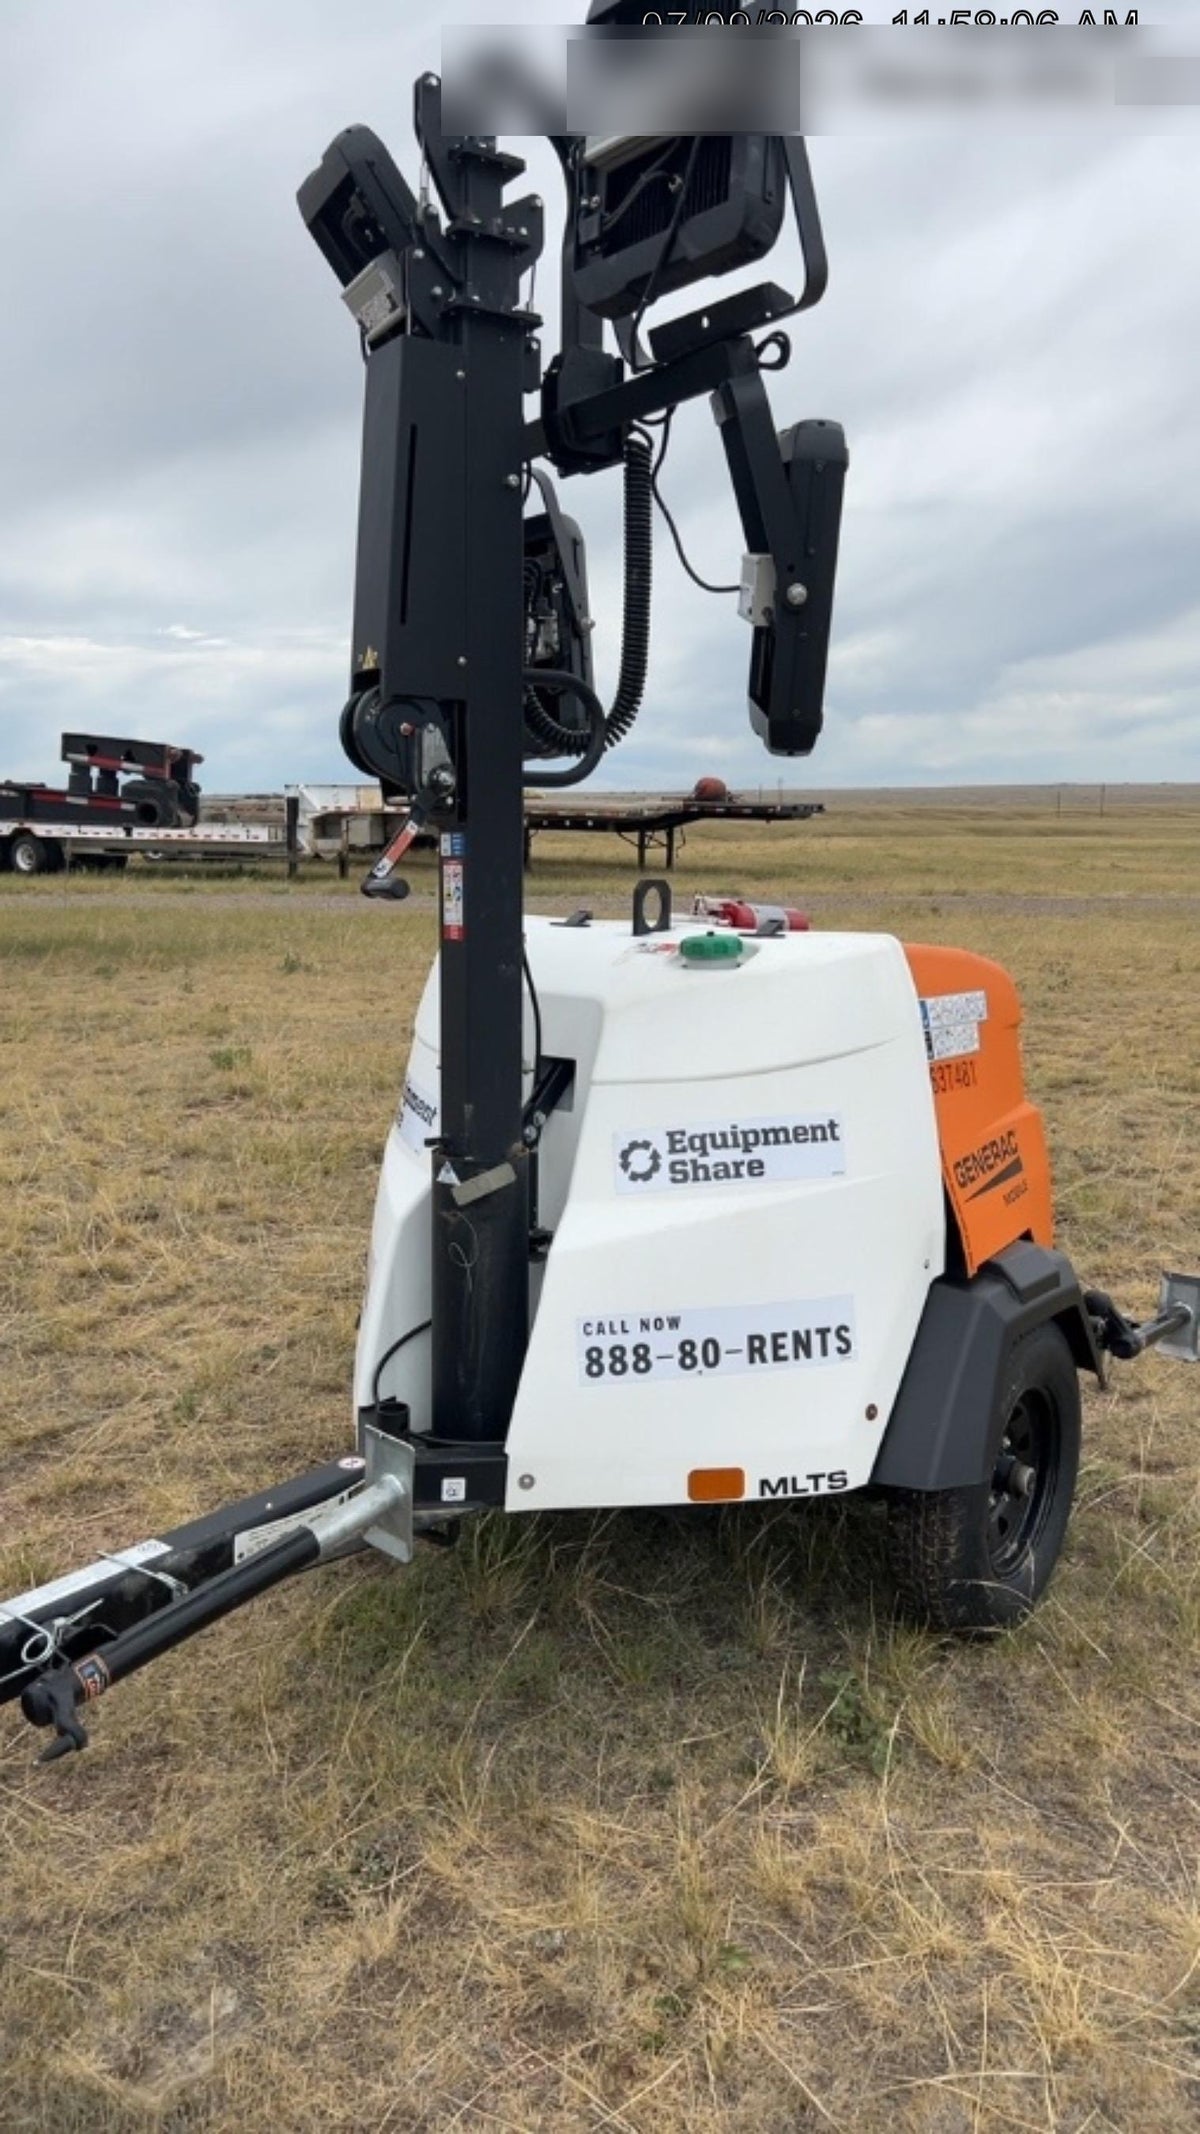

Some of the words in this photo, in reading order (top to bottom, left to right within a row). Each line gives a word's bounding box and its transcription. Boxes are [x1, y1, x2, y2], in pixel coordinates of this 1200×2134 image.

[665, 1119, 840, 1157] Equipment
[669, 1158, 765, 1184] Share
[953, 1130, 1019, 1188] GENERAC
[583, 1317, 630, 1336] CALL
[640, 1316, 682, 1333] NOW
[584, 1325, 852, 1378] 888-80-RENTS
[759, 1470, 848, 1497] MLTS
